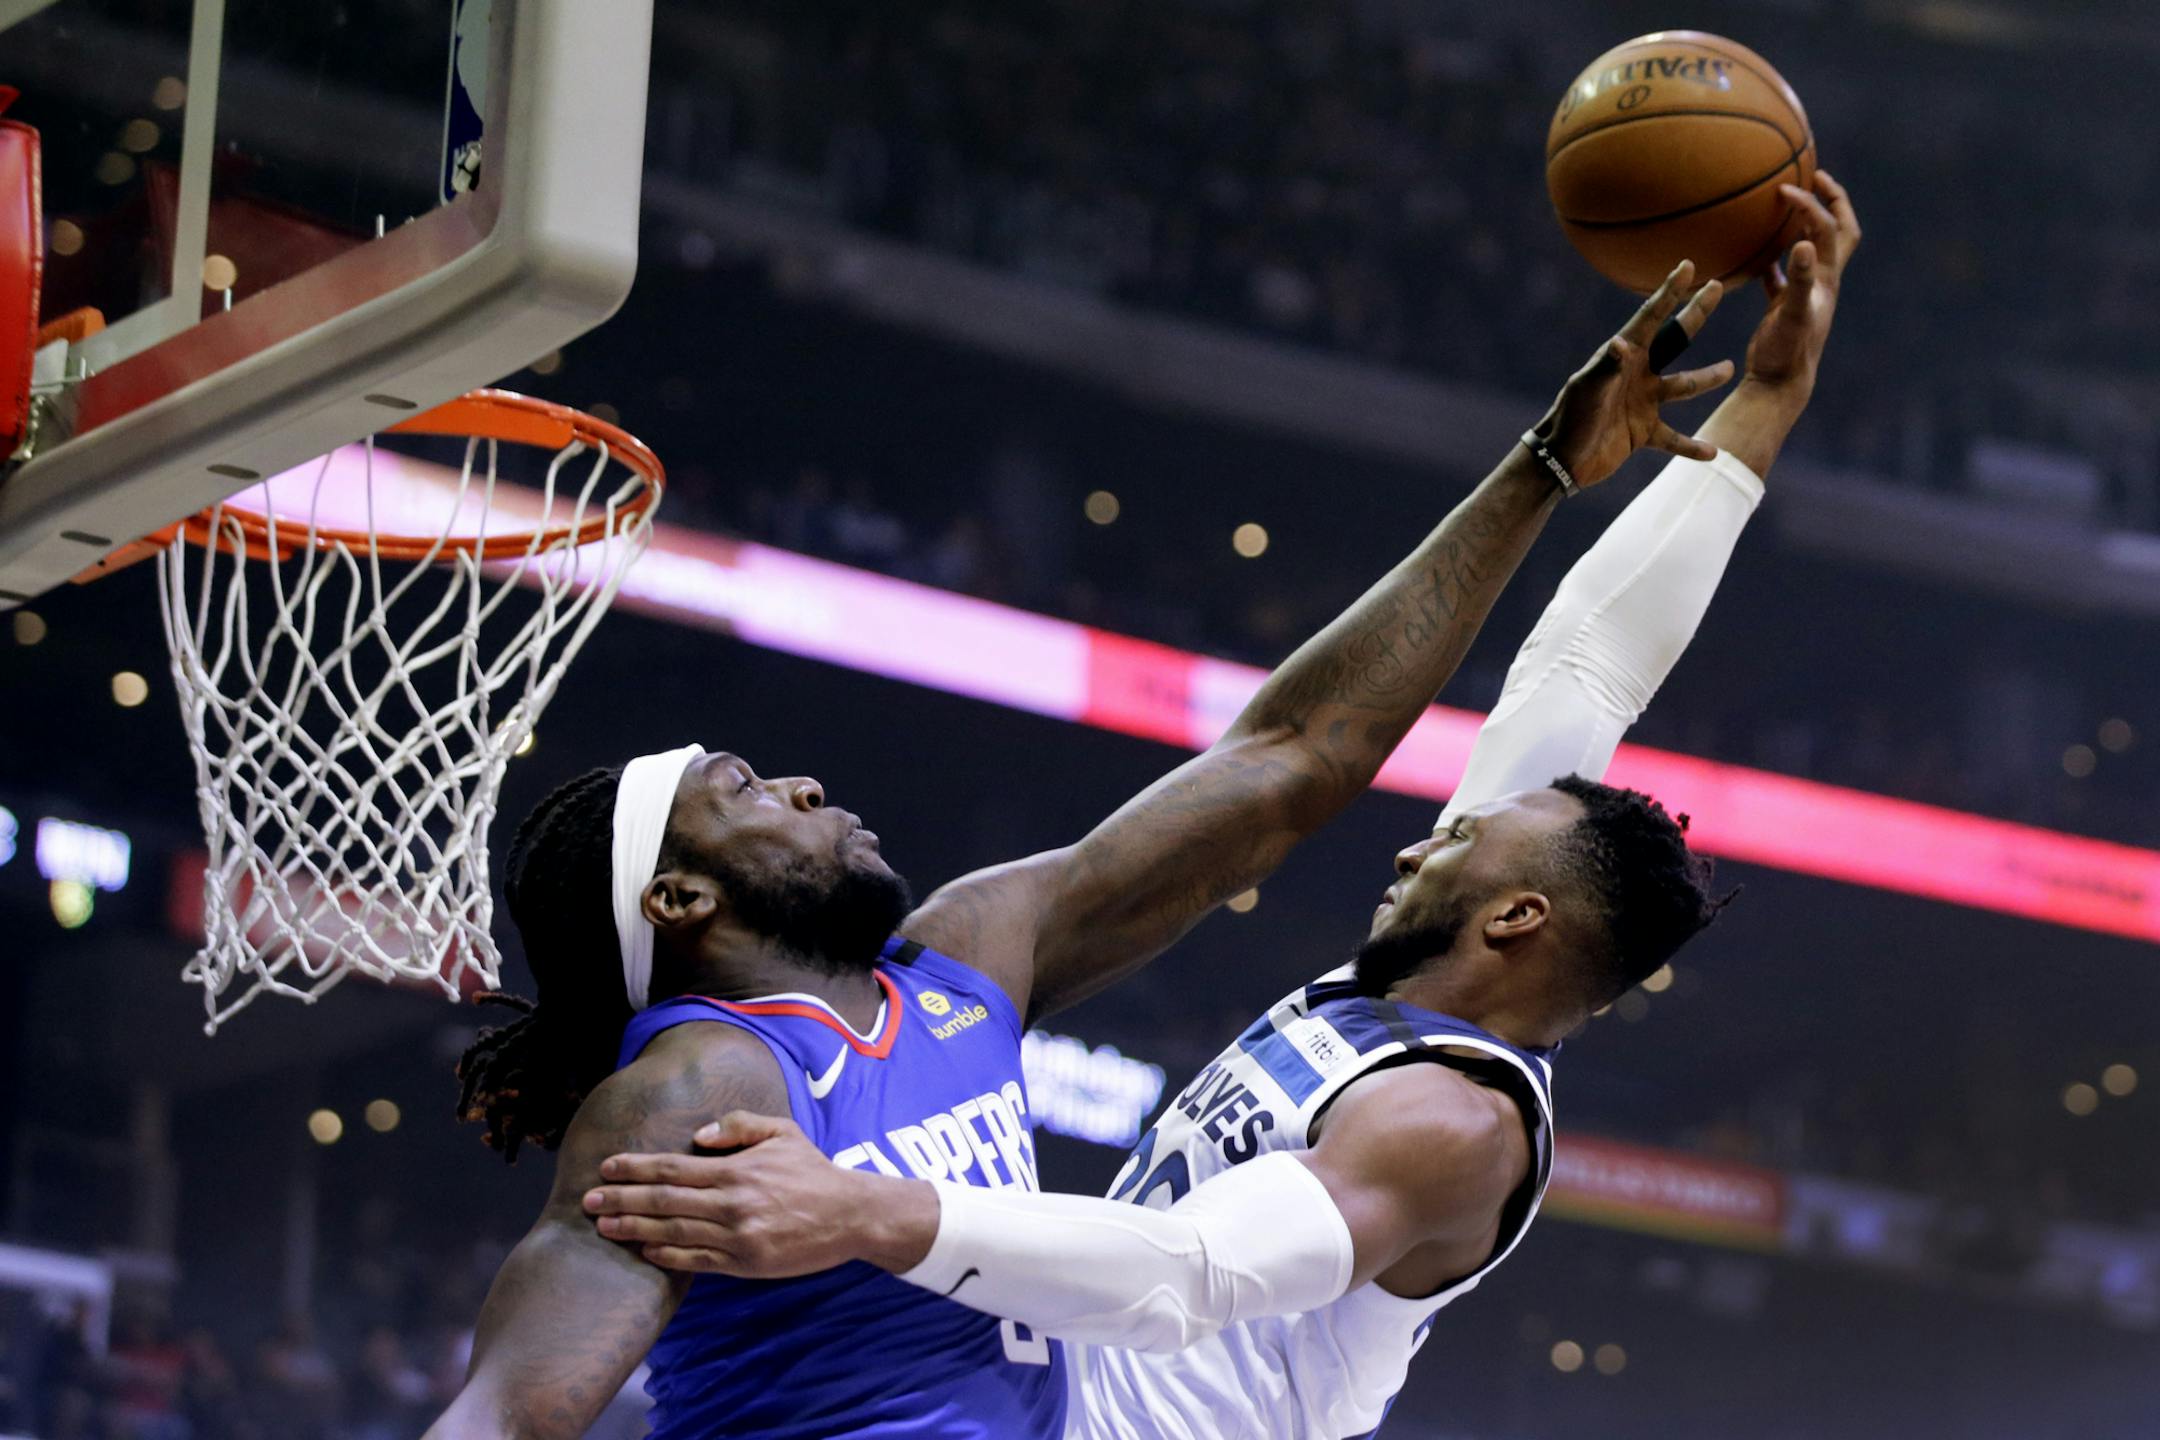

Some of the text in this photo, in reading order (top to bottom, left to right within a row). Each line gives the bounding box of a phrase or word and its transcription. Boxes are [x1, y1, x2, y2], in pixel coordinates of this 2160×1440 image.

[1561, 55, 1733, 125] SPALDG
[926, 1004, 988, 1041] bumble
[1305, 1031, 1340, 1067] fitb
